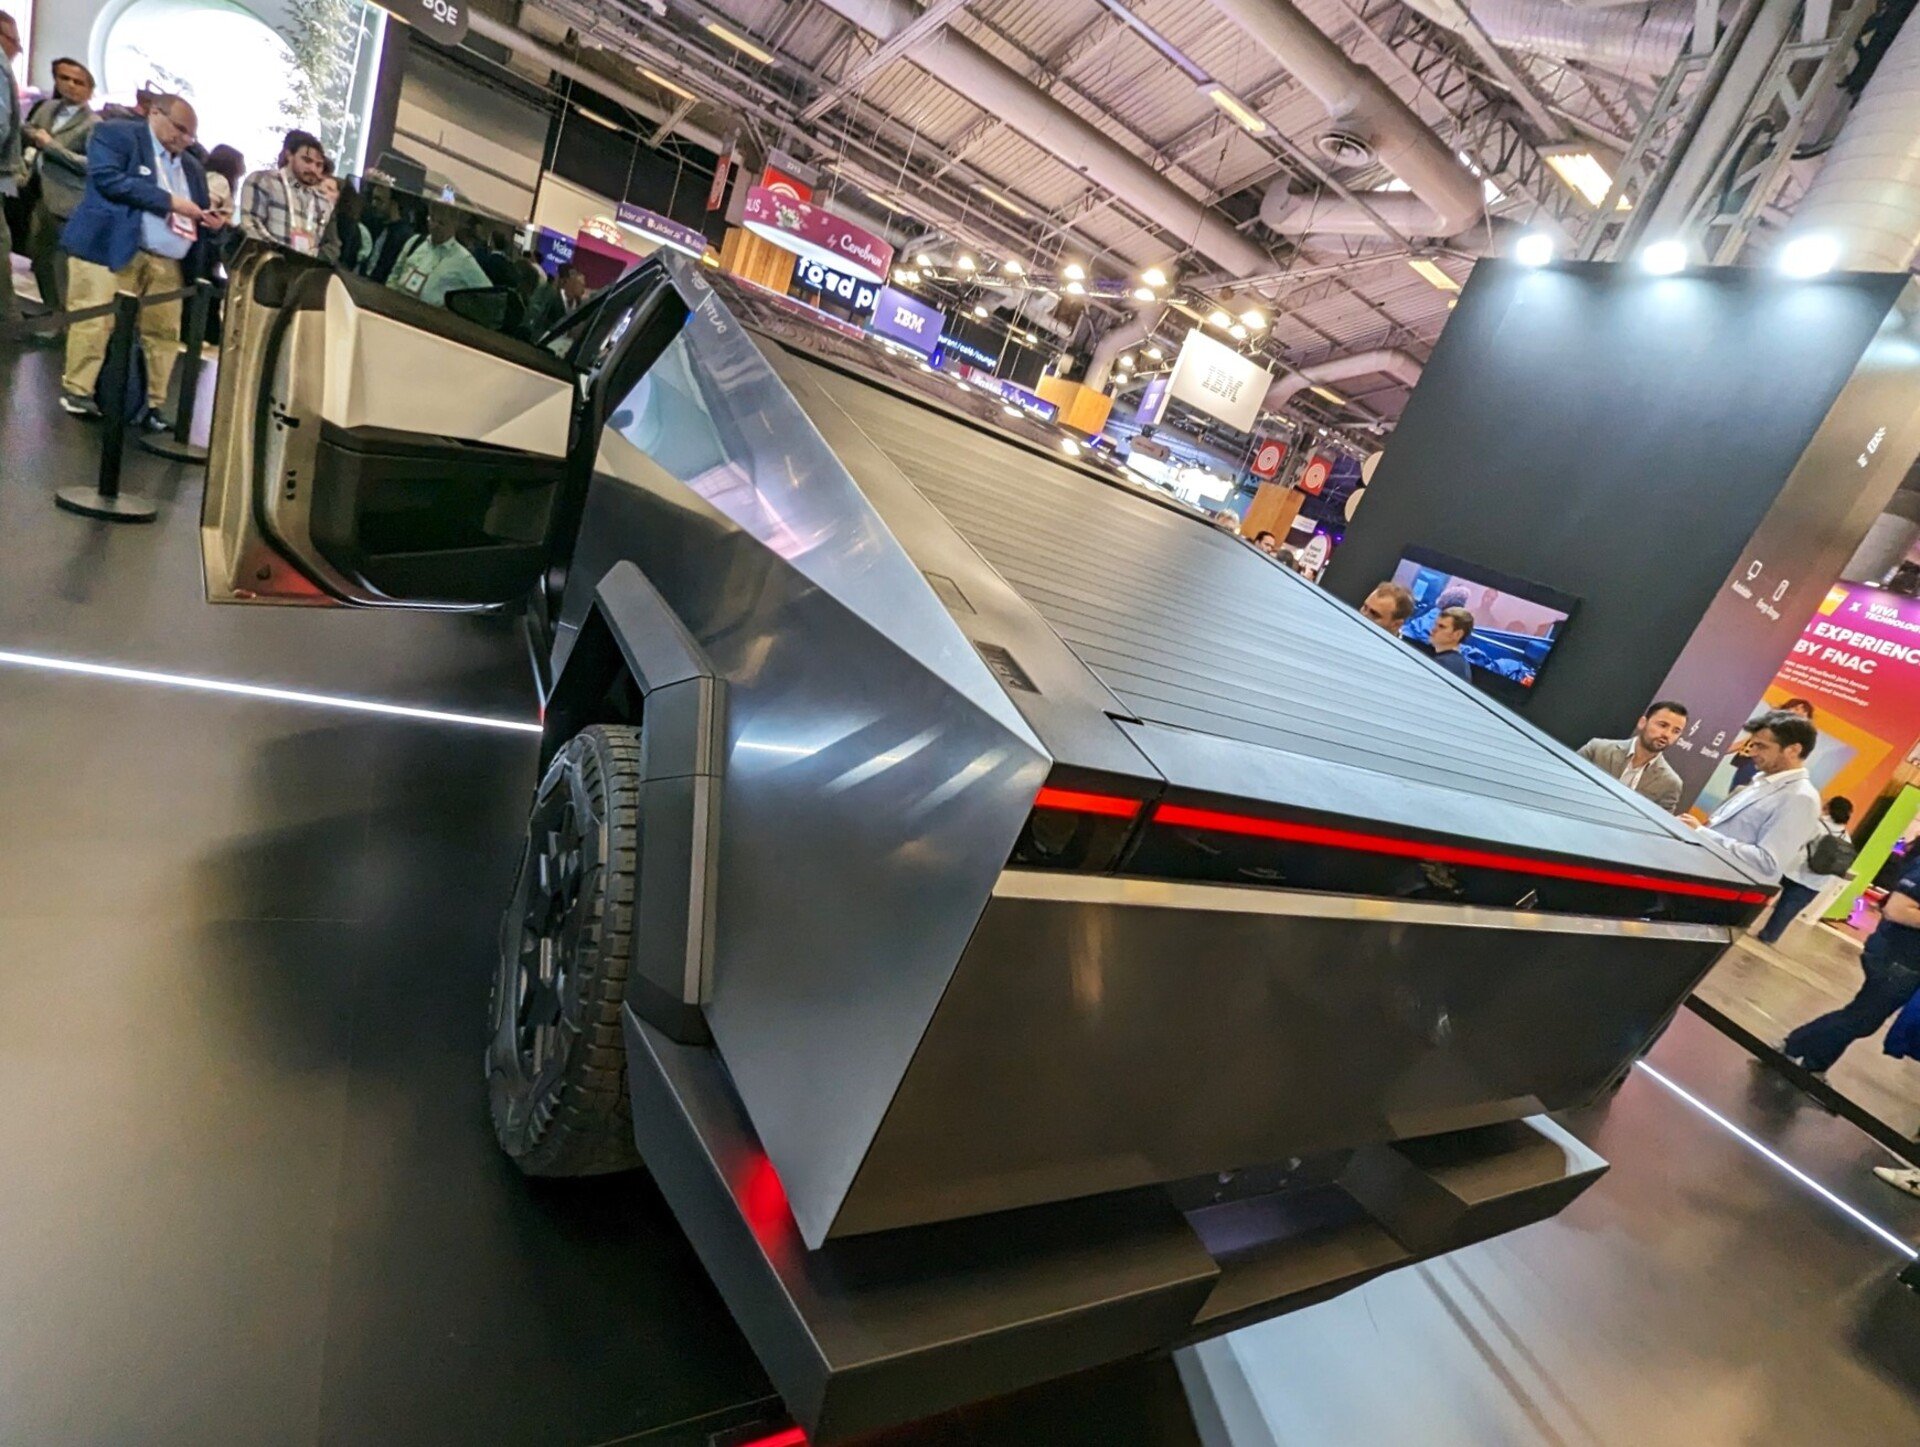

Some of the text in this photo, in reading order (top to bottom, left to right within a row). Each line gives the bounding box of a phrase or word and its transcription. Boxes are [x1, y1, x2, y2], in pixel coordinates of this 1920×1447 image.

[422, 0, 458, 26] BOE
[893, 306, 926, 334] IBM
[1201, 365, 1244, 403] IBM
[1864, 611, 1920, 634] TECHNOLOG
[1869, 602, 1899, 619] VIVA
[1793, 638, 1878, 675] BY FNAC
[1813, 621, 1920, 666] EXPERIENC
